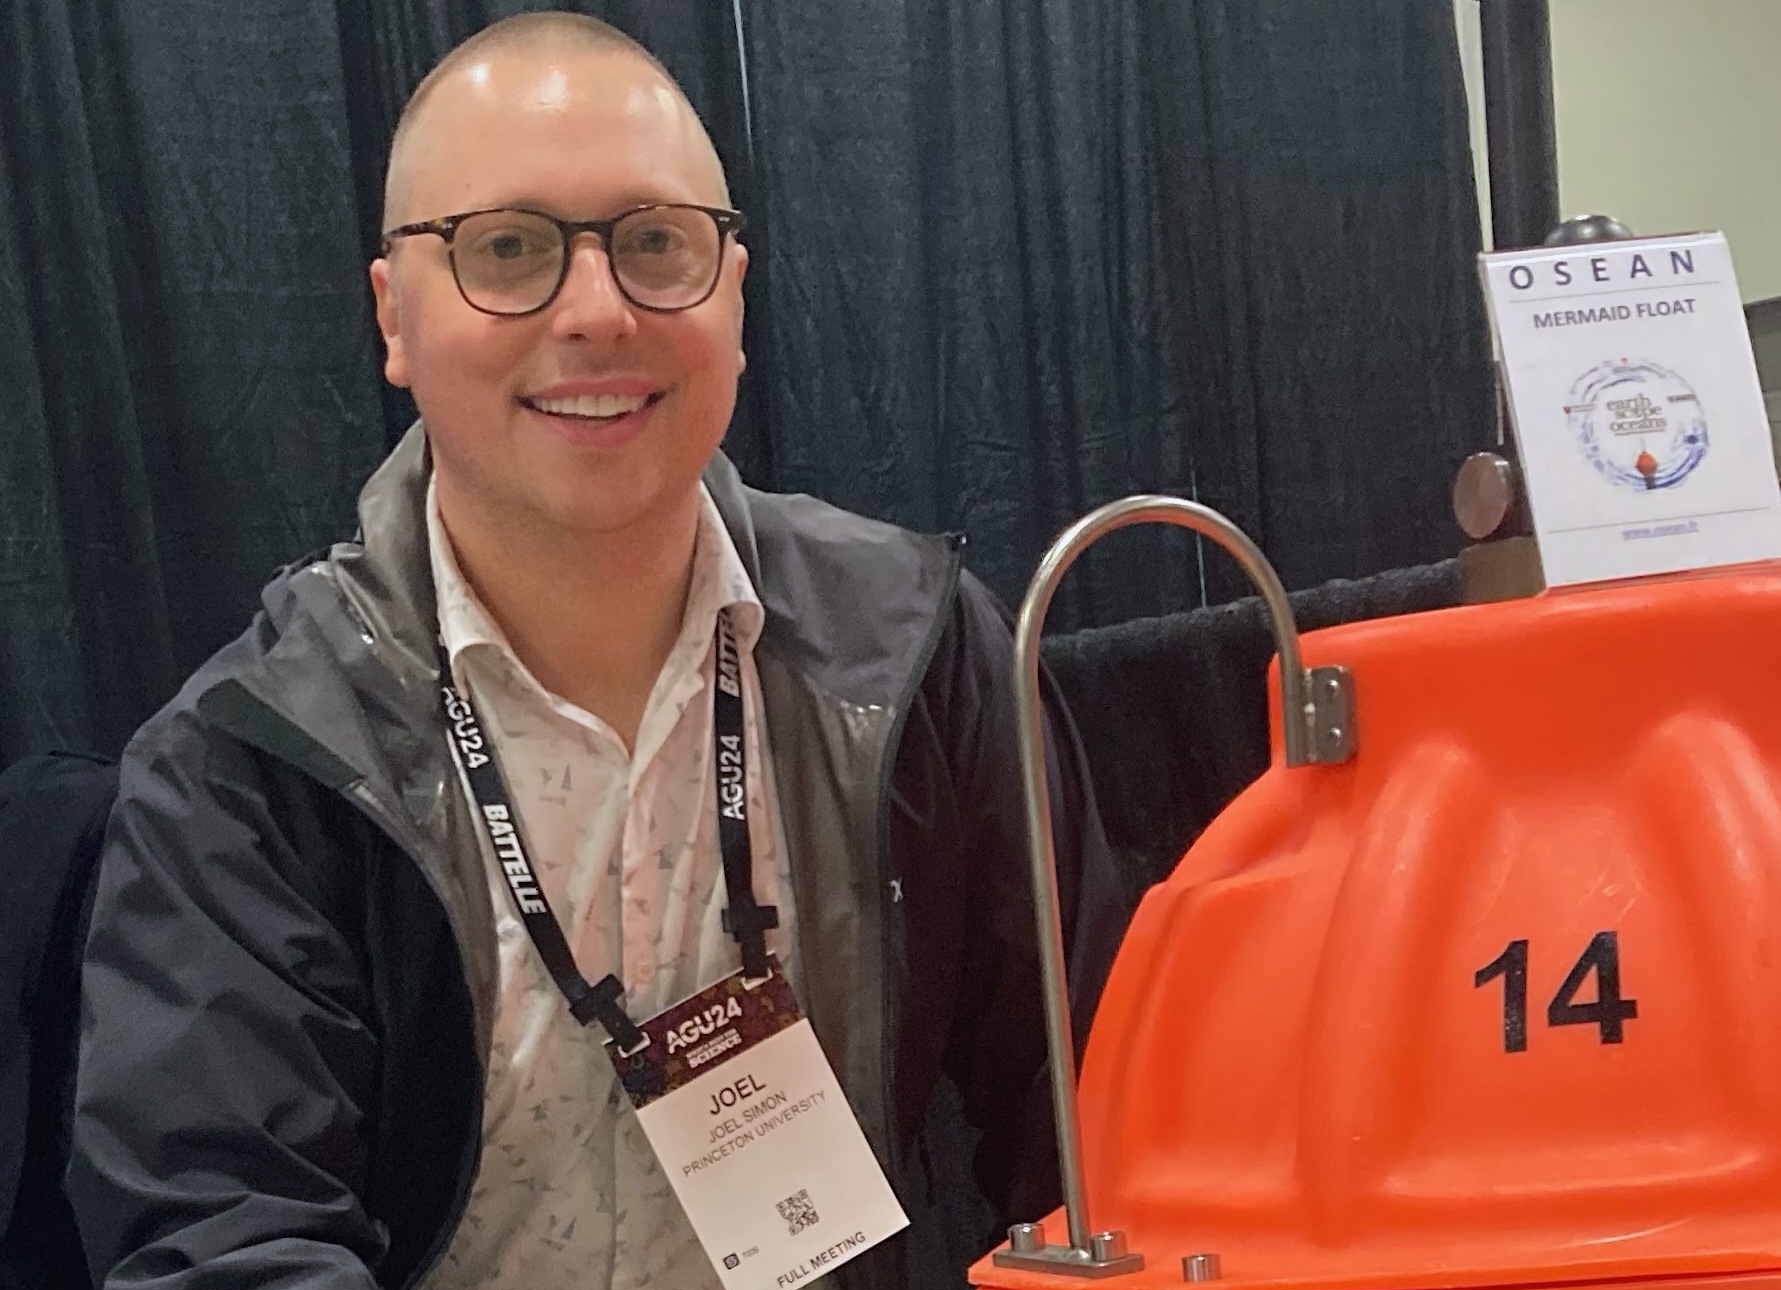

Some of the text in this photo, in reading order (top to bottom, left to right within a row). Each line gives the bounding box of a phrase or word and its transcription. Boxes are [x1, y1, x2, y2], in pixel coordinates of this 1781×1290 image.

[1509, 250, 1695, 290] OSEAN
[1533, 299, 1697, 329] MERMAID FLOAT
[721, 735, 746, 821] AGU24
[483, 804, 547, 915] BATTELLE
[1474, 931, 1638, 1053] 14
[666, 996, 743, 1054] AGU24
[709, 1091, 787, 1144] JOEL SIMON
[710, 1074, 766, 1115] JOEL
[682, 1090, 826, 1177] PRINCETON UNIVERSITY
[776, 1231, 867, 1288] FULL MEETING
